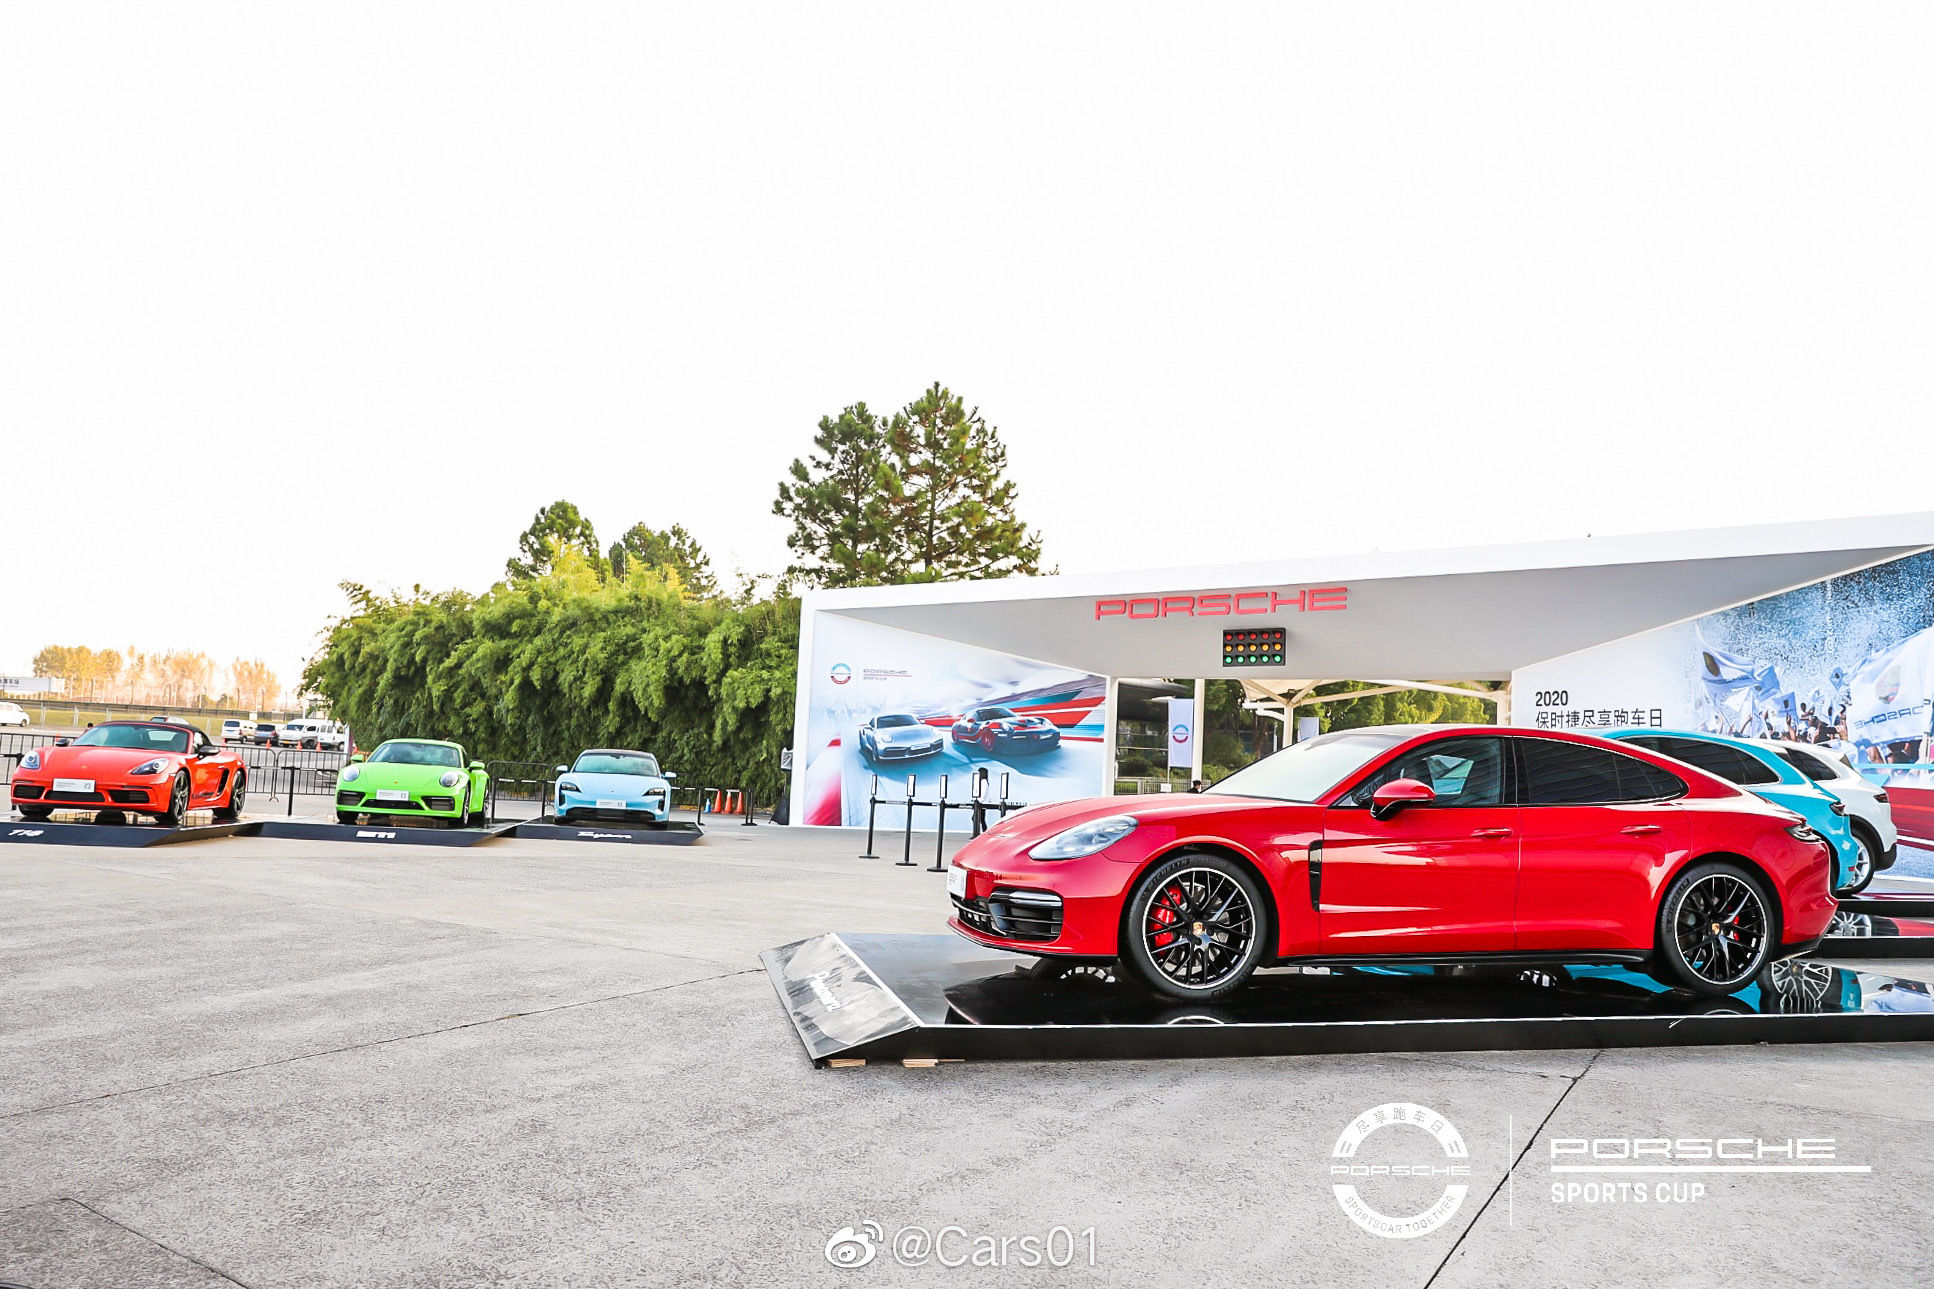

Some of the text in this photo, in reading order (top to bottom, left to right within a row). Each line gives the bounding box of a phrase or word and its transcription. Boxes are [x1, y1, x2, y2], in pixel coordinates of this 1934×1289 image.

[1095, 587, 1347, 620] PORSCHE
[1535, 690, 1568, 707] 2020
[1535, 708, 1662, 729] 保时捷尽享跑车日
